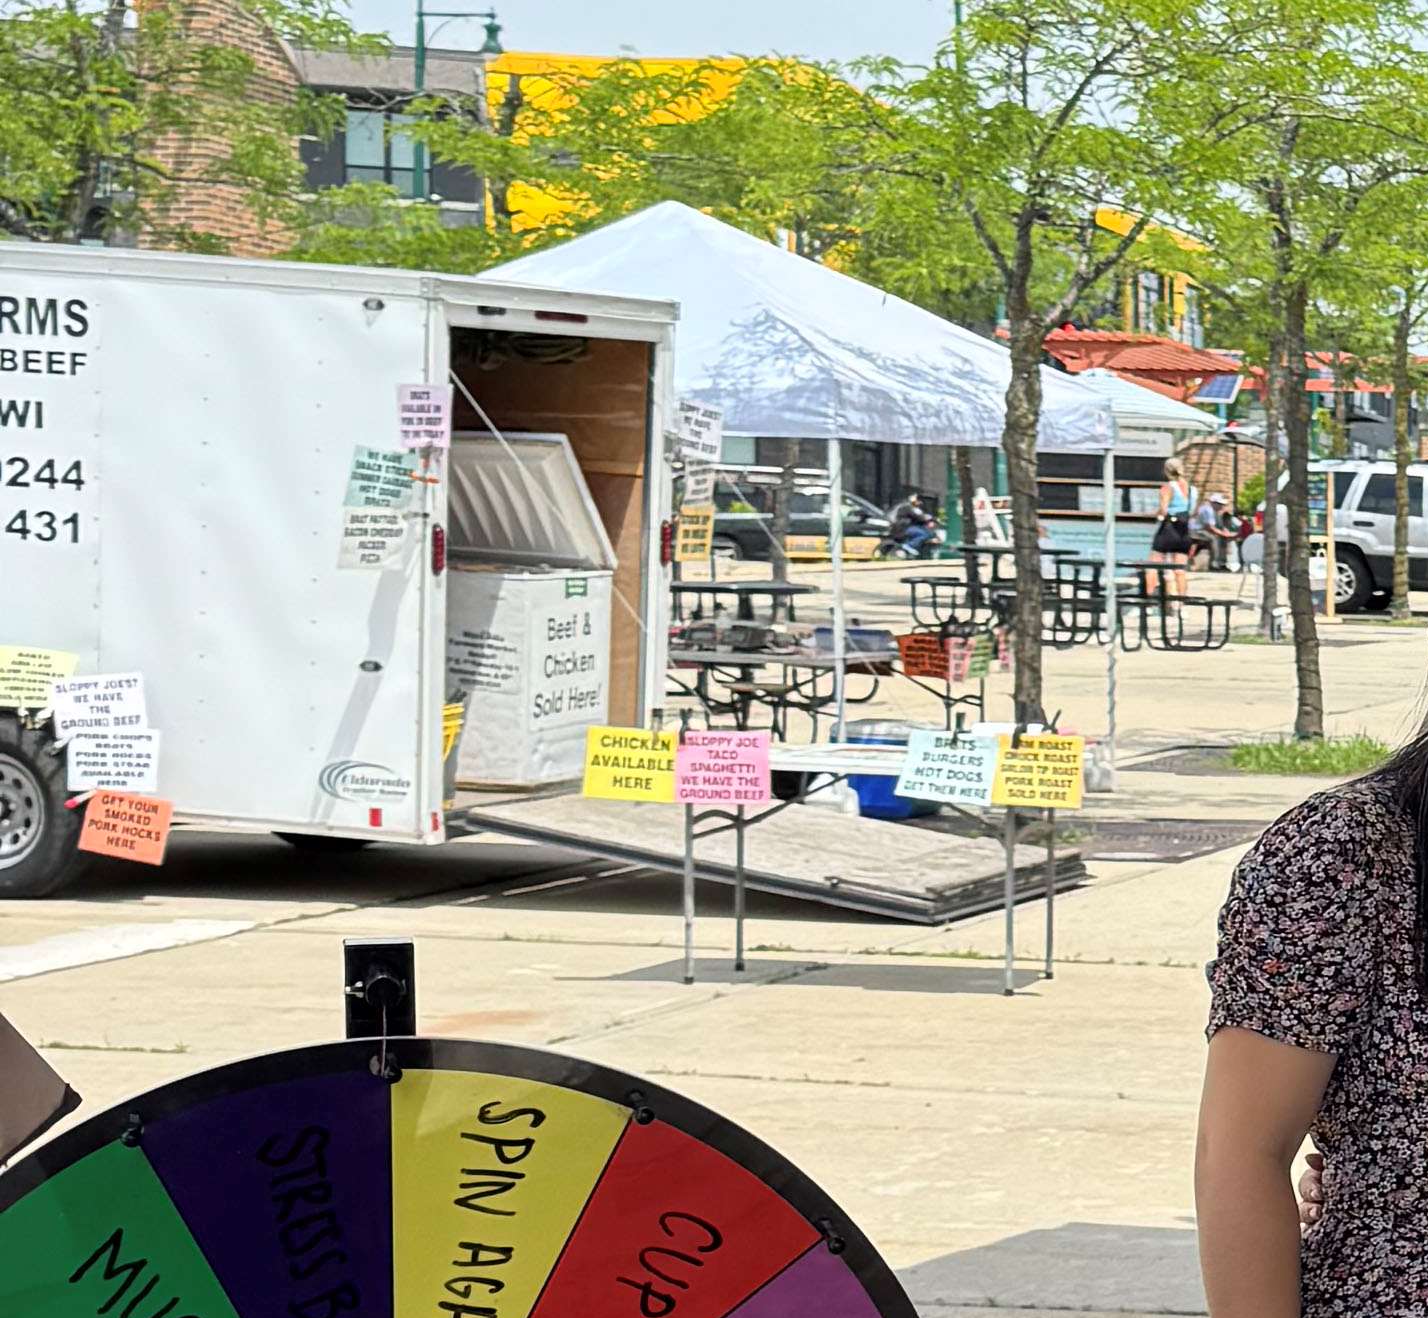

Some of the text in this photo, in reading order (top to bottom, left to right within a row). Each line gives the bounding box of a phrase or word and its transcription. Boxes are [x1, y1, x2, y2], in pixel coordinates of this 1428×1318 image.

[0, 349, 87, 375] BEEF
[0, 399, 43, 428] WI
[5, 509, 79, 543] 431
[547, 613, 592, 641] Beef &
[544, 653, 595, 678] Chicken
[533, 683, 603, 718] Sold Here!
[591, 756, 675, 771] AVAILABLE
[612, 775, 653, 791] HERE
[454, 1100, 546, 1216] SPIN
[257, 1125, 346, 1280] STRESS
[617, 1210, 723, 1318] CUP
